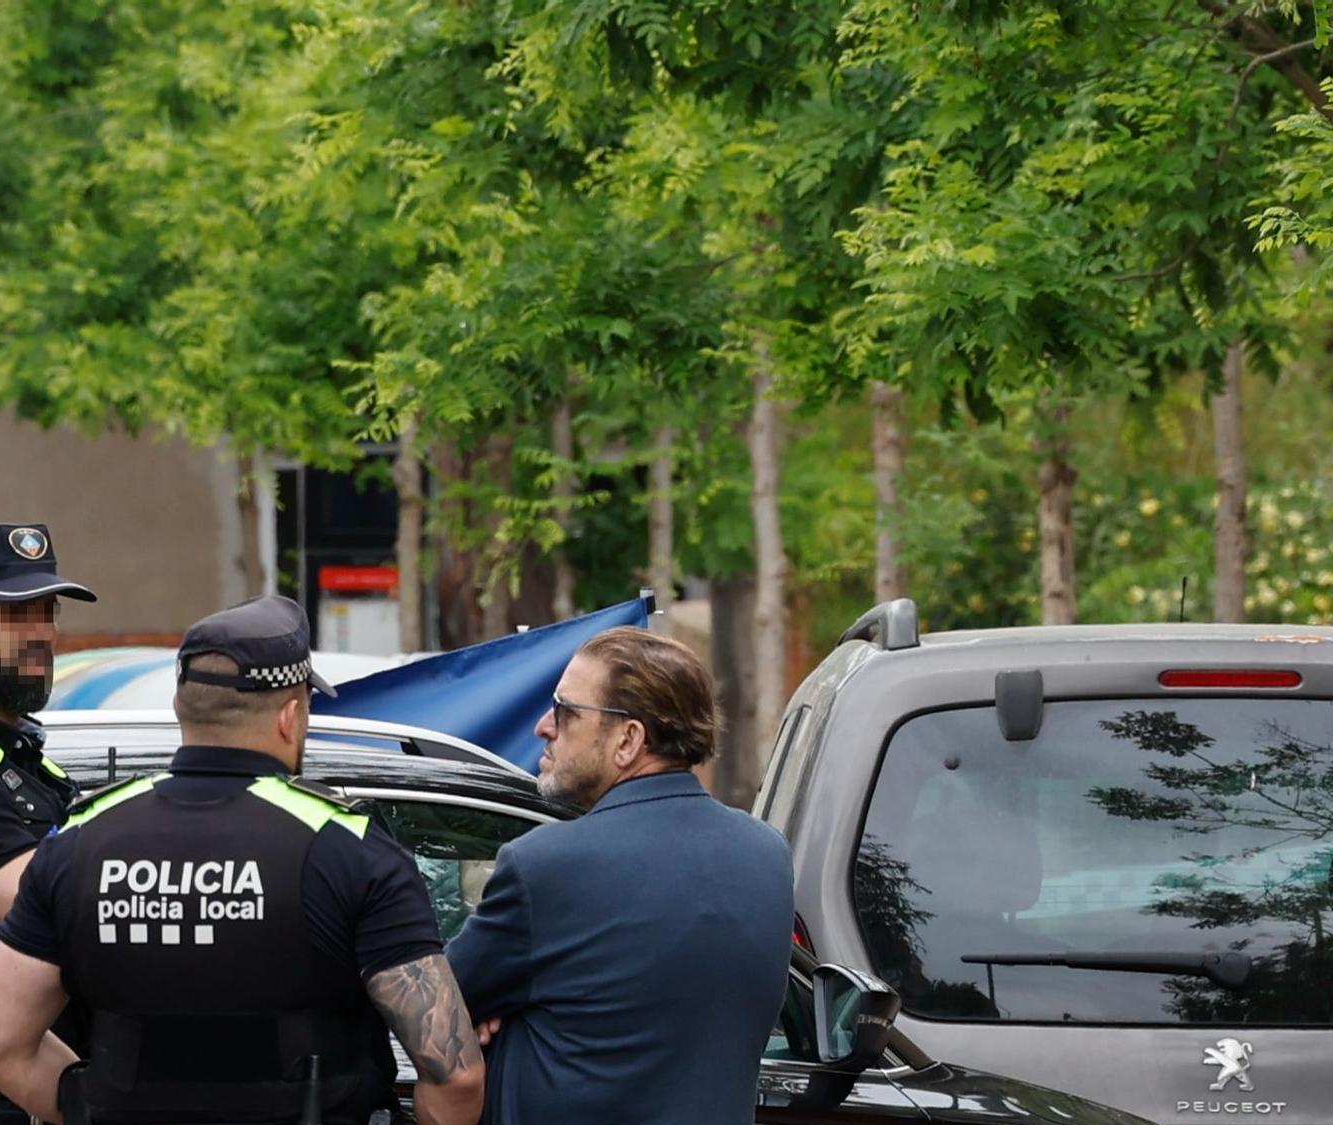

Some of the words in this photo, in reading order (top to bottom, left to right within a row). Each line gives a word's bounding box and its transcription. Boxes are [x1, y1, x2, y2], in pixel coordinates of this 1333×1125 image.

[99, 860, 264, 894] POLICIA
[98, 895, 183, 923] policia
[200, 896, 264, 920] local
[1177, 1101, 1285, 1113] PEUGEOT
